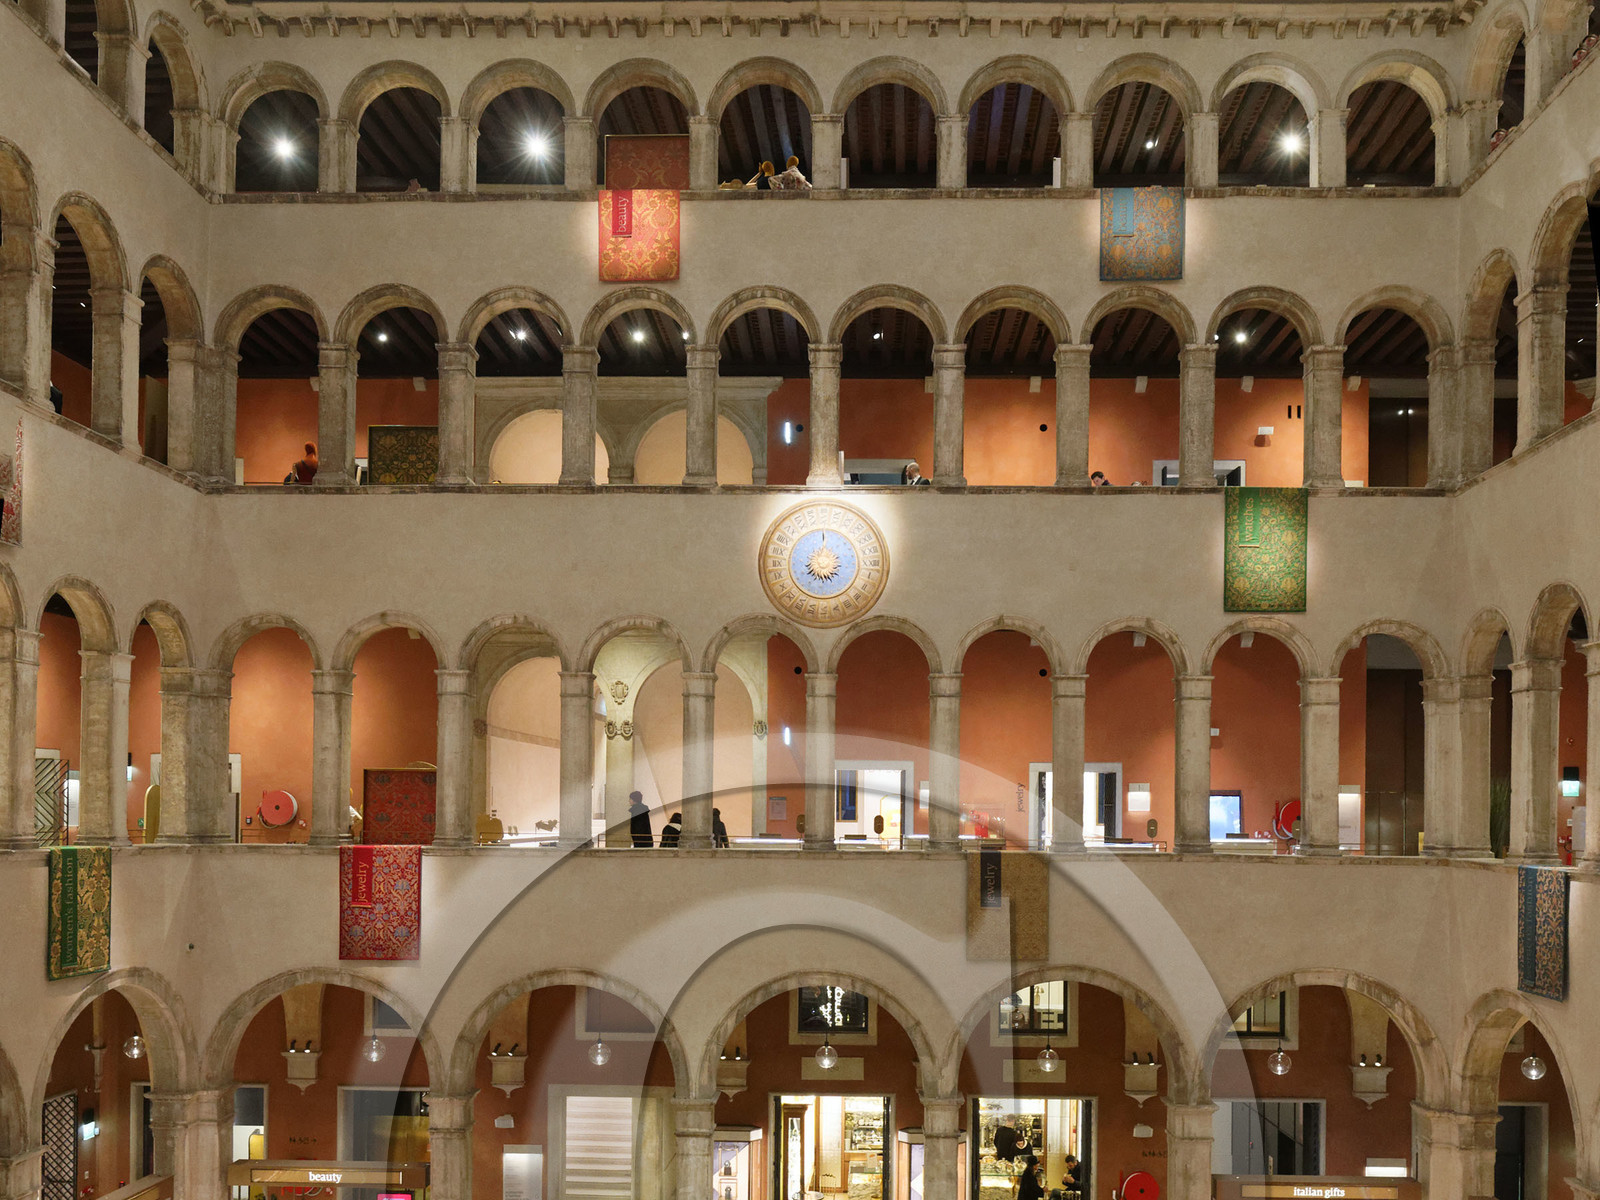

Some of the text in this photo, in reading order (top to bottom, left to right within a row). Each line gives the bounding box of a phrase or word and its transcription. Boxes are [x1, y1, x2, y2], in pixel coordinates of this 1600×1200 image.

[617, 196, 629, 233] beauty
[1243, 497, 1254, 542] watches
[1016, 782, 1025, 813] jewelry
[355, 861, 369, 903] jewelry
[984, 863, 998, 904] jewelry
[65, 857, 74, 963] women's fashion
[308, 1171, 342, 1184] beauty
[1293, 1186, 1345, 1199] italian gifts
